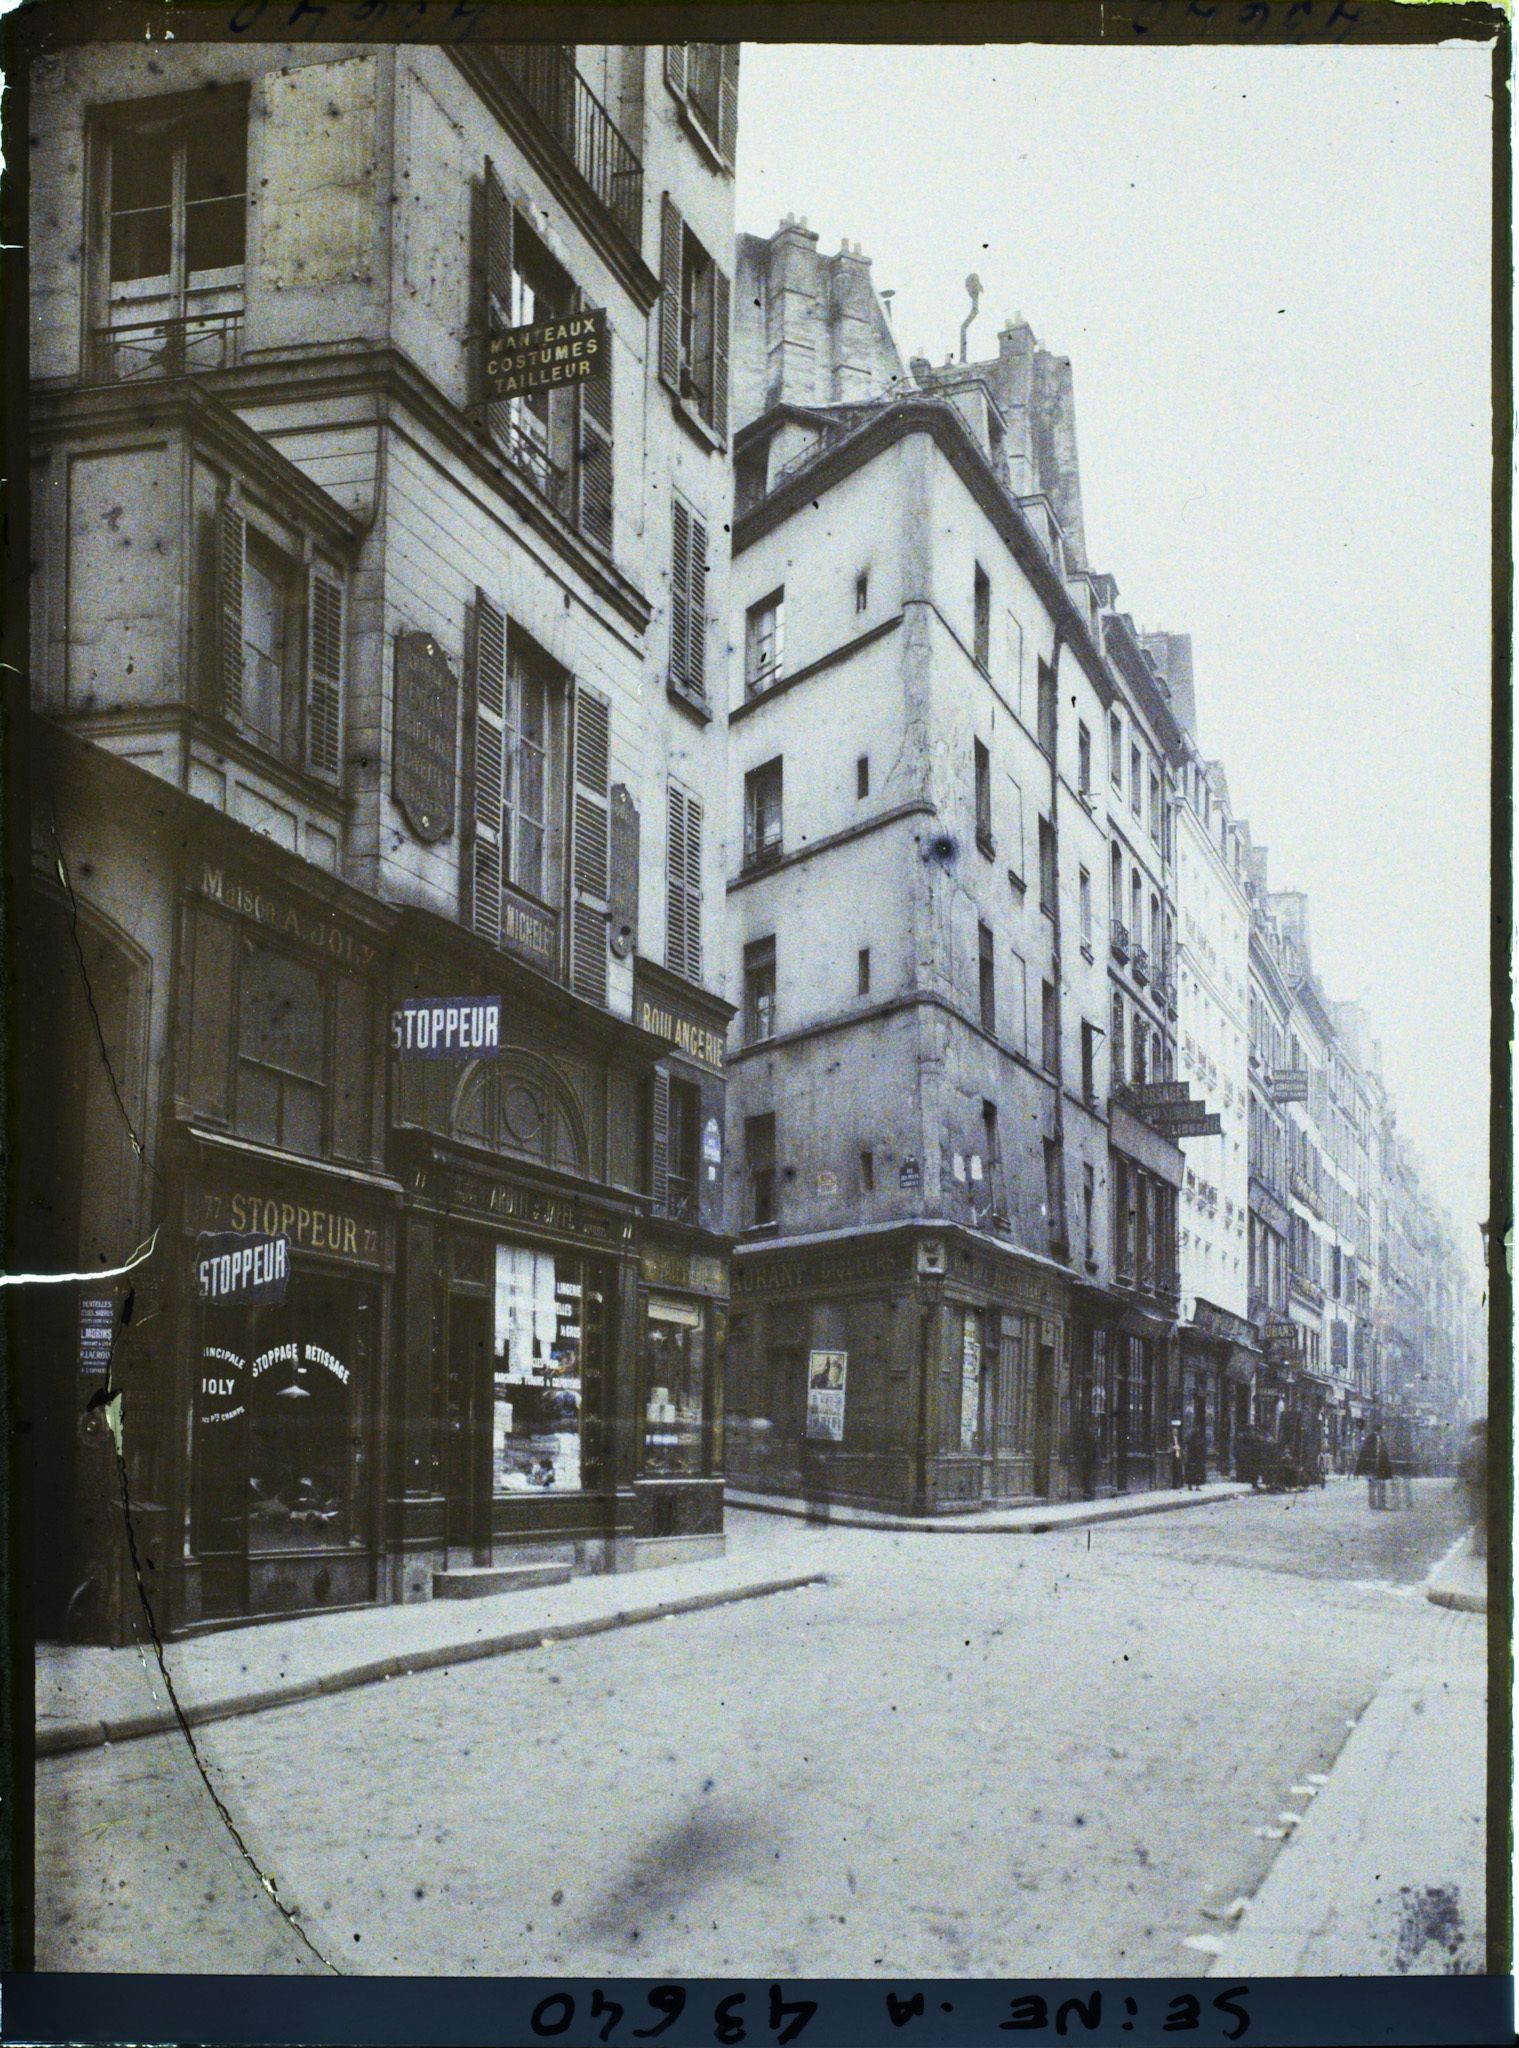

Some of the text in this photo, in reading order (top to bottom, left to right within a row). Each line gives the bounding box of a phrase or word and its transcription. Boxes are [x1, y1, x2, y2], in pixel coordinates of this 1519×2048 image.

[487, 339, 598, 375] COSTUMES
[490, 318, 596, 354] MANTEAUX
[495, 360, 591, 393] TAILLEUR
[202, 862, 276, 928] Maison
[506, 904, 556, 956] MICHELET
[391, 1006, 499, 1049] STOPPEUR
[643, 1002, 723, 1068] BOULANGERIE
[231, 1194, 357, 1253] STOPPEUR
[199, 1239, 285, 1297] STOPPEUR
[252, 1342, 351, 1385] STOPPAGE RÉTISSAGE
[530, 1984, 818, 2047] 43640
